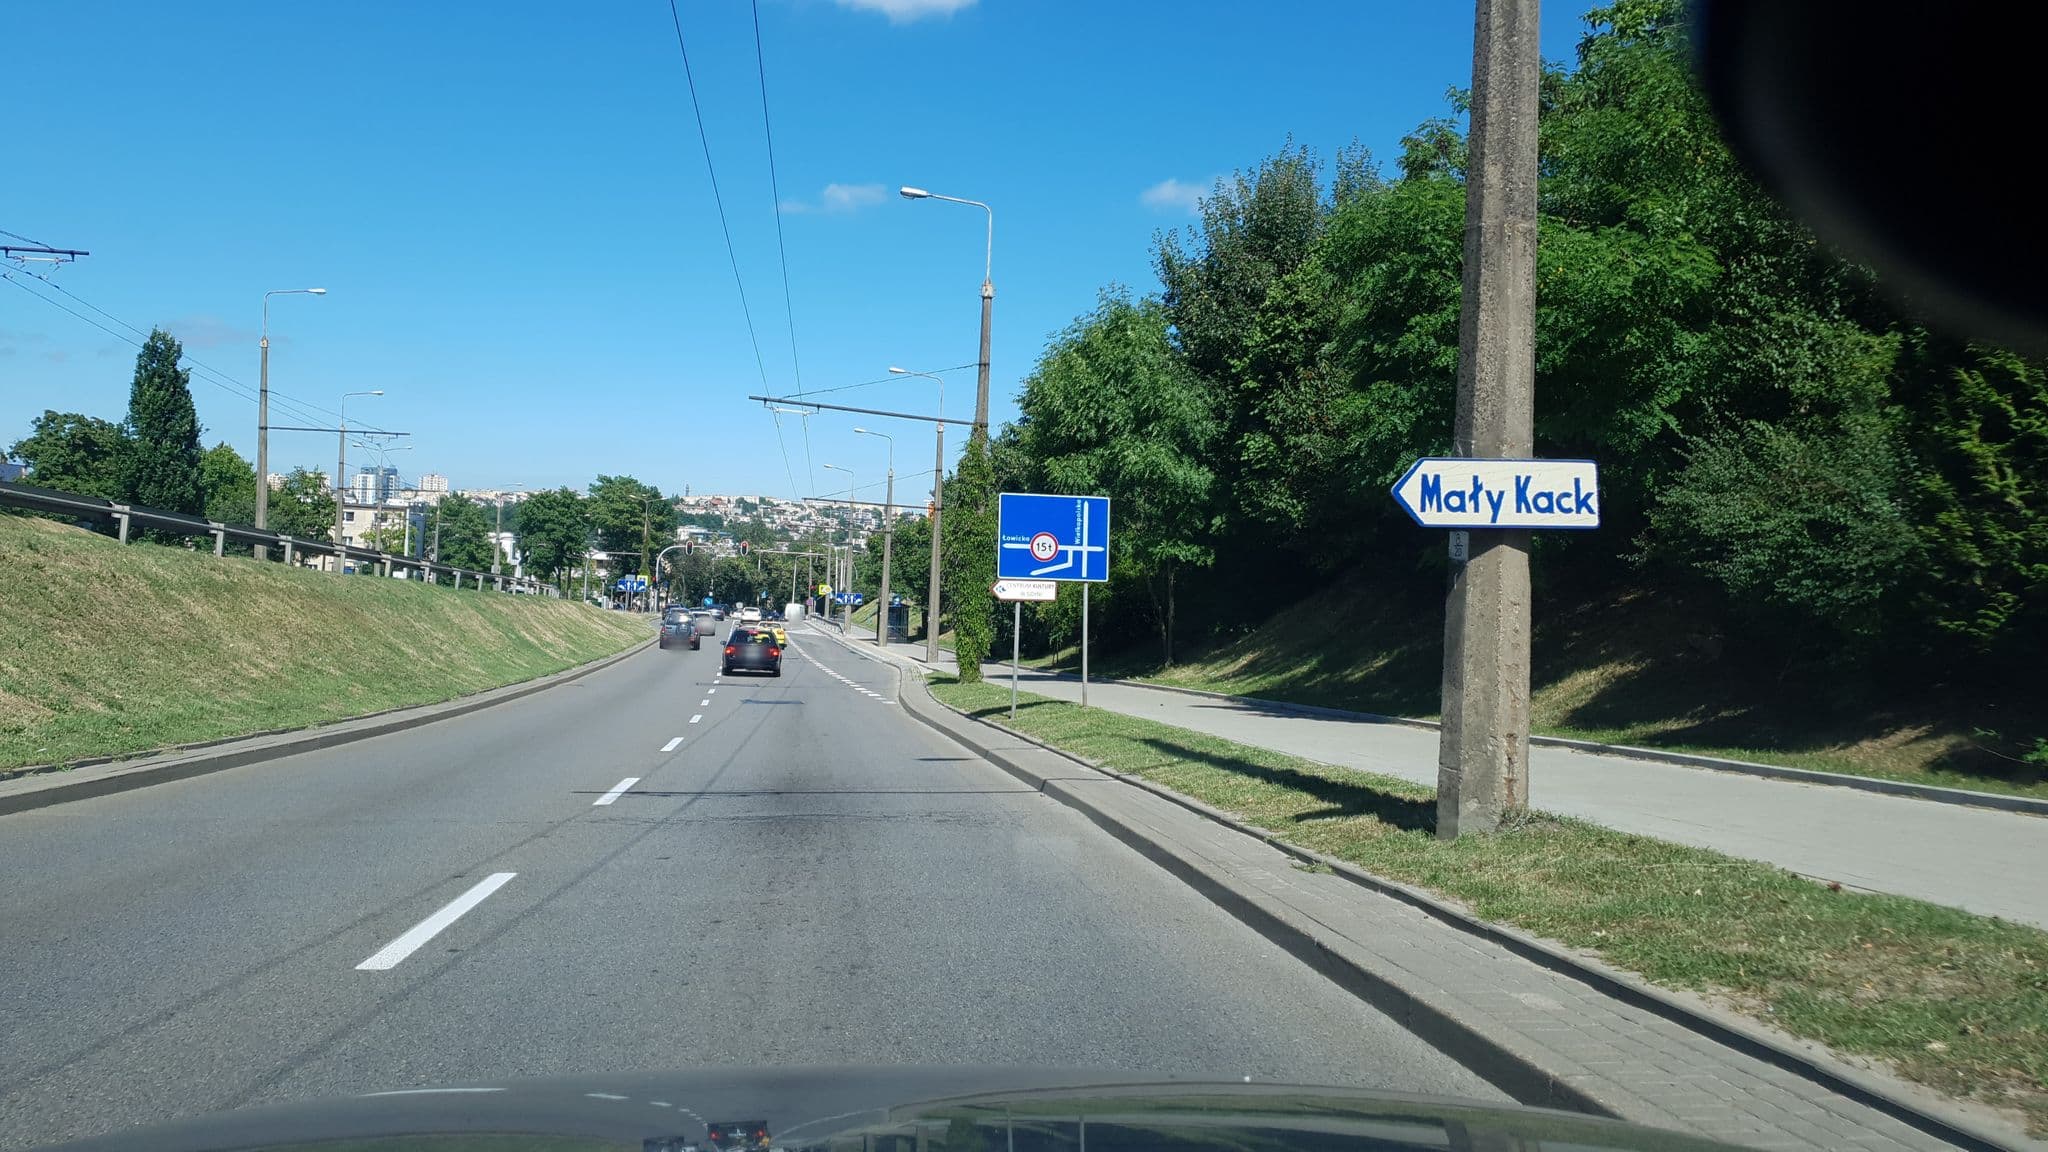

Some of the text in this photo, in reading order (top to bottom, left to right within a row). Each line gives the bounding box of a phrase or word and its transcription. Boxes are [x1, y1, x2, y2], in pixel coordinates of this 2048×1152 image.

[1420, 473, 1596, 523] Mały Kack
[1002, 534, 1031, 542] Łowicka
